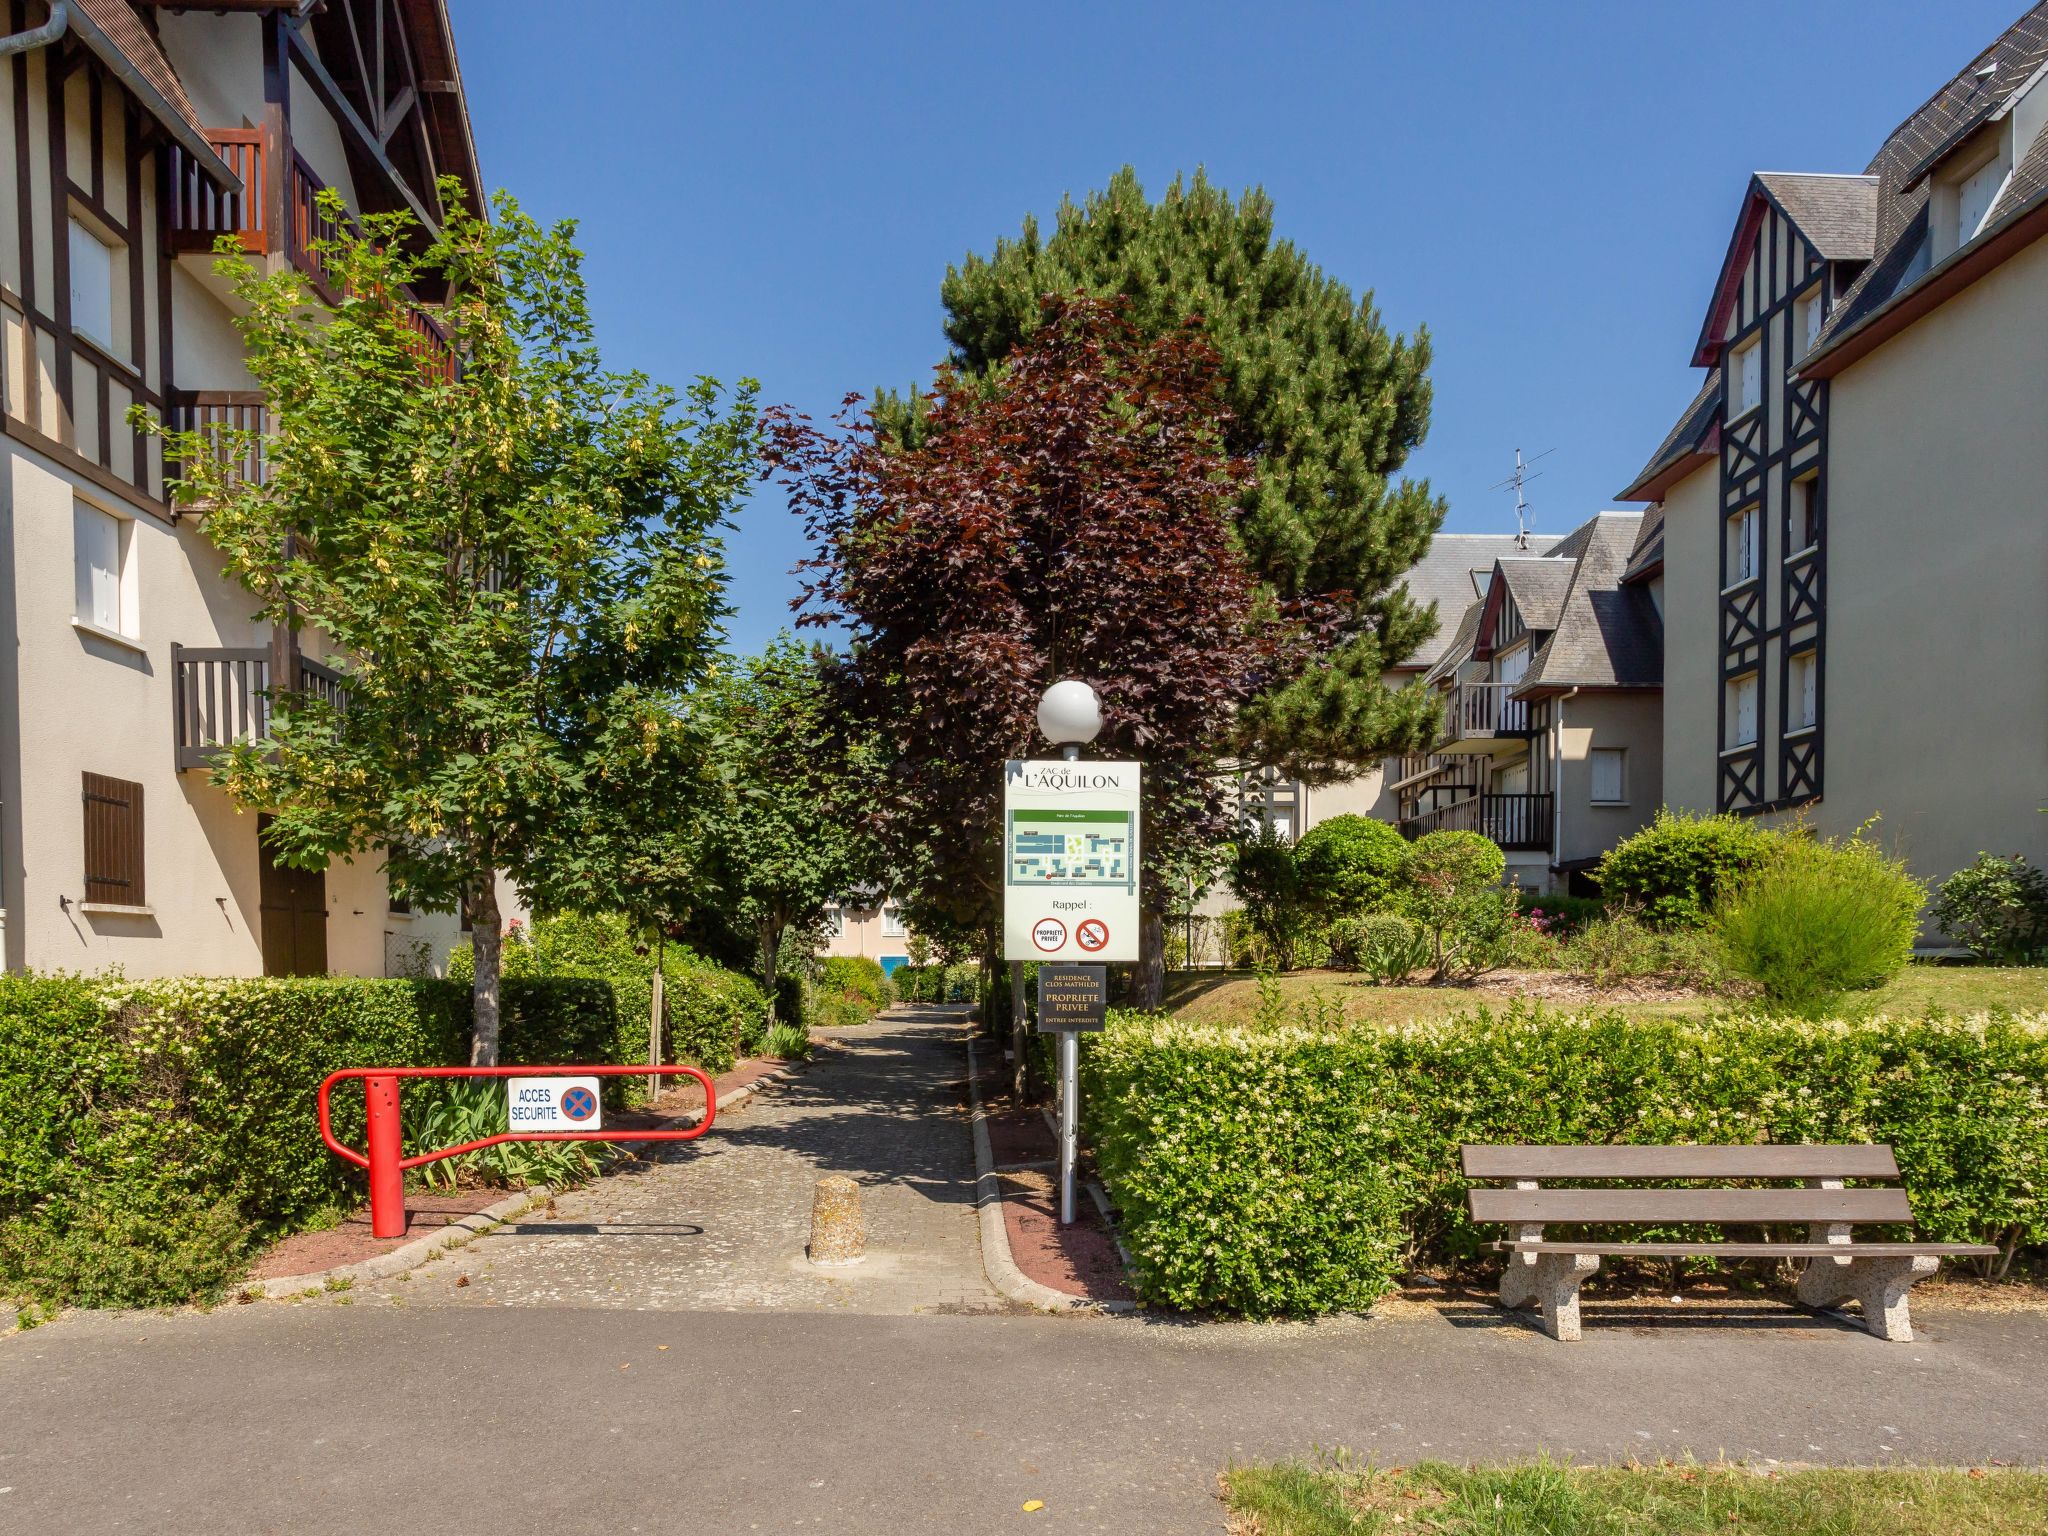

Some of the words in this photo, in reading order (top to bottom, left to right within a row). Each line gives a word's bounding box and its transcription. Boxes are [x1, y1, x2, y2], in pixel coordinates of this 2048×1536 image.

[1040, 767, 1059, 775] ZAC
[1060, 767, 1071, 775] de
[1025, 774, 1119, 791] L'AQUILON
[1052, 900, 1087, 911] Rappel
[1046, 994, 1099, 1002] PROPRIETE
[1056, 1003, 1089, 1011] PRIVEE
[519, 1089, 551, 1102] ACCES
[512, 1106, 557, 1120] SECURITE
